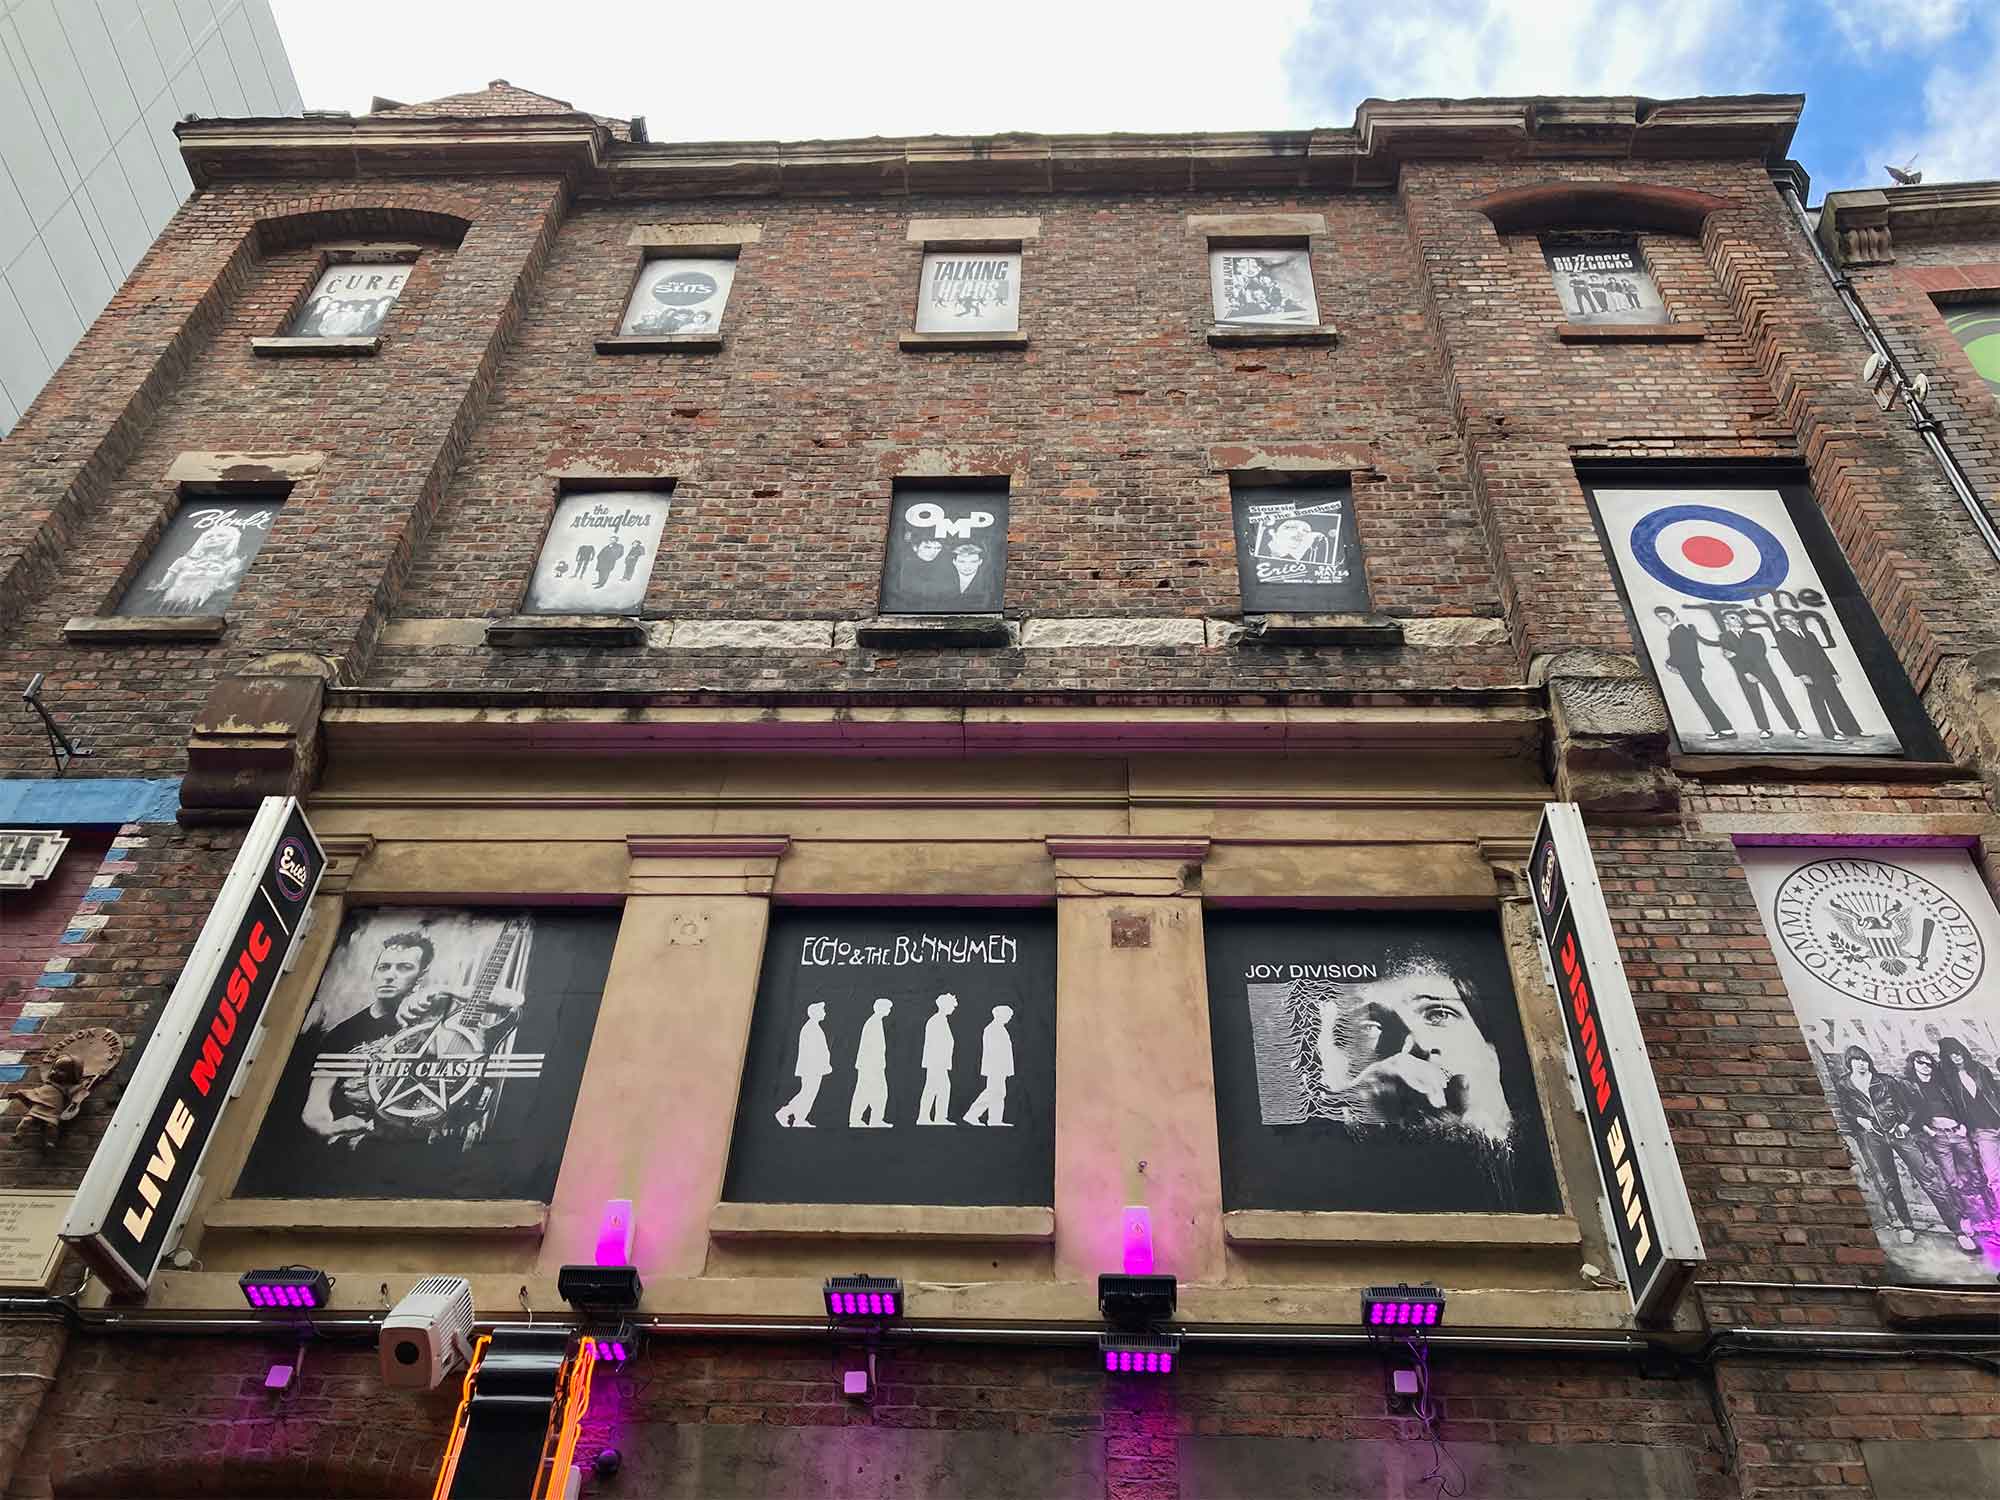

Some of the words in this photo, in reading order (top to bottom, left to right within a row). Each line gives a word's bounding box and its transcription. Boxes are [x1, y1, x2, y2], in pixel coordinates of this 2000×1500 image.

[934, 261, 1009, 280] TALKING
[326, 275, 403, 294] CURE
[188, 509, 272, 530] Blondie
[570, 509, 652, 533] stranglers
[594, 504, 609, 515] the
[1799, 861, 1920, 891] JOHNNY
[1780, 890, 1842, 985] TOMMY
[1930, 895, 1979, 957] JOEY
[801, 936, 851, 966] ECHO
[894, 933, 1017, 966] BUNNYMEN
[1245, 964, 1284, 979] JOY
[1289, 964, 1377, 979] DIVISION
[1560, 931, 1612, 1115] MUSIC
[122, 1098, 196, 1243] LIVE
[190, 920, 274, 1098] MUSIC
[369, 1061, 410, 1078] THE
[415, 1061, 485, 1078] CLASH
[1606, 1116, 1652, 1266] LIVE
